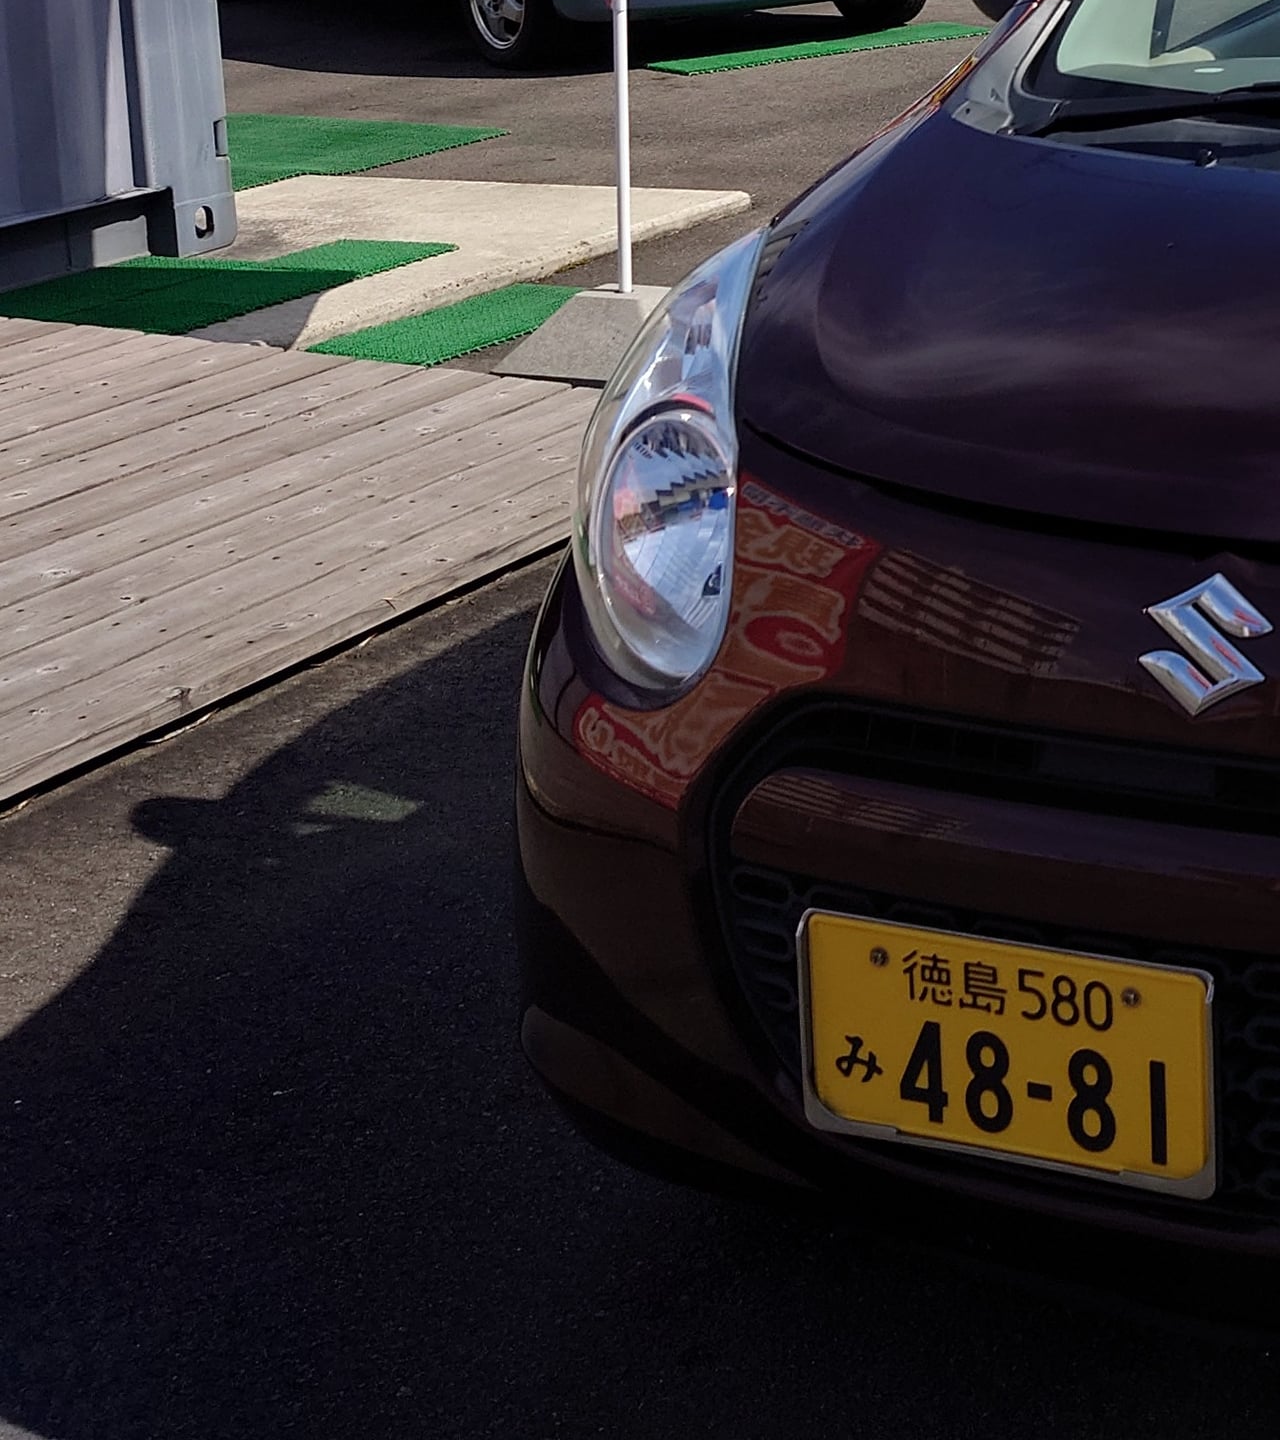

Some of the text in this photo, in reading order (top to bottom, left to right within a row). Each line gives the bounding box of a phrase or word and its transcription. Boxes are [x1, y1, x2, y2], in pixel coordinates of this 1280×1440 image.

[901, 948, 1115, 1032] 徳島 580
[834, 1019, 1170, 1167] み 48-81
